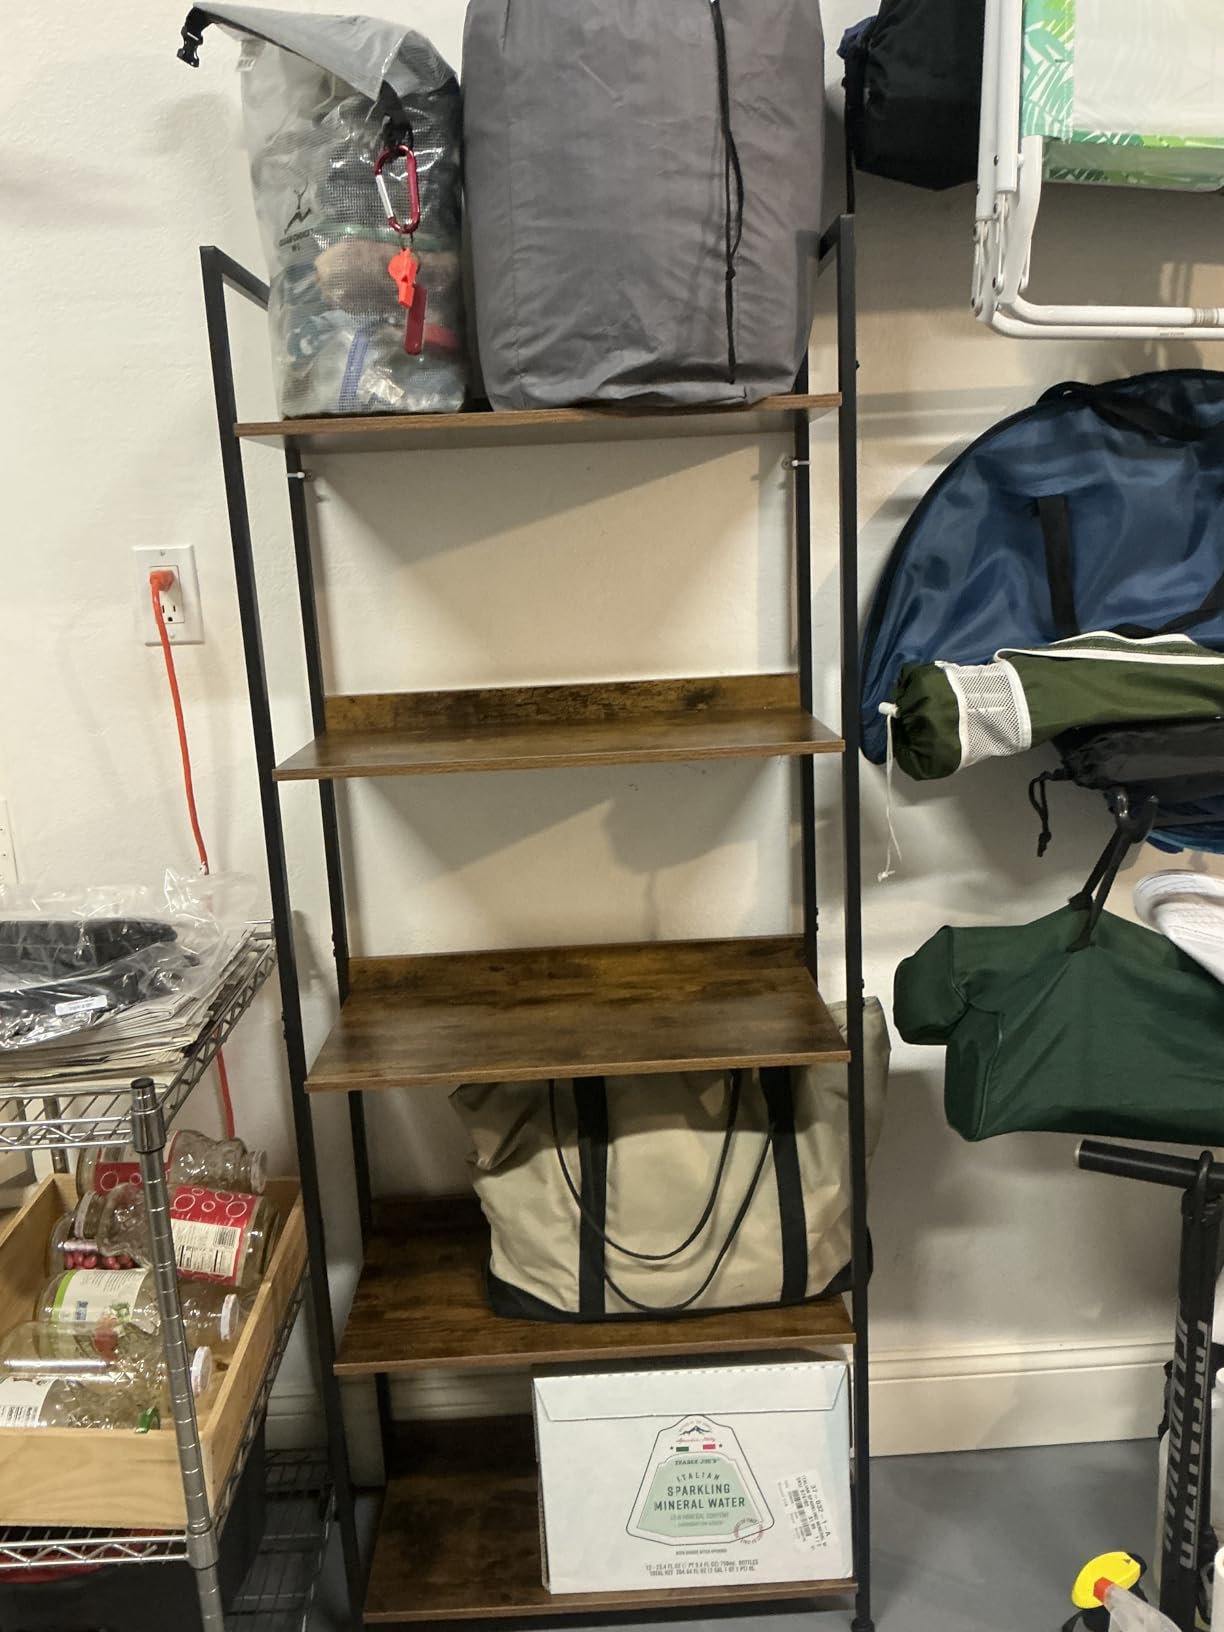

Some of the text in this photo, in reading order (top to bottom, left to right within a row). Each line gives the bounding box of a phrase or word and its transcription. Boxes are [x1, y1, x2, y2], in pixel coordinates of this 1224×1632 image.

[676, 1472, 720, 1482] ITALIAN
[667, 1484, 730, 1496] SPARKLING
[654, 1497, 745, 1511] MINERAL WATER
